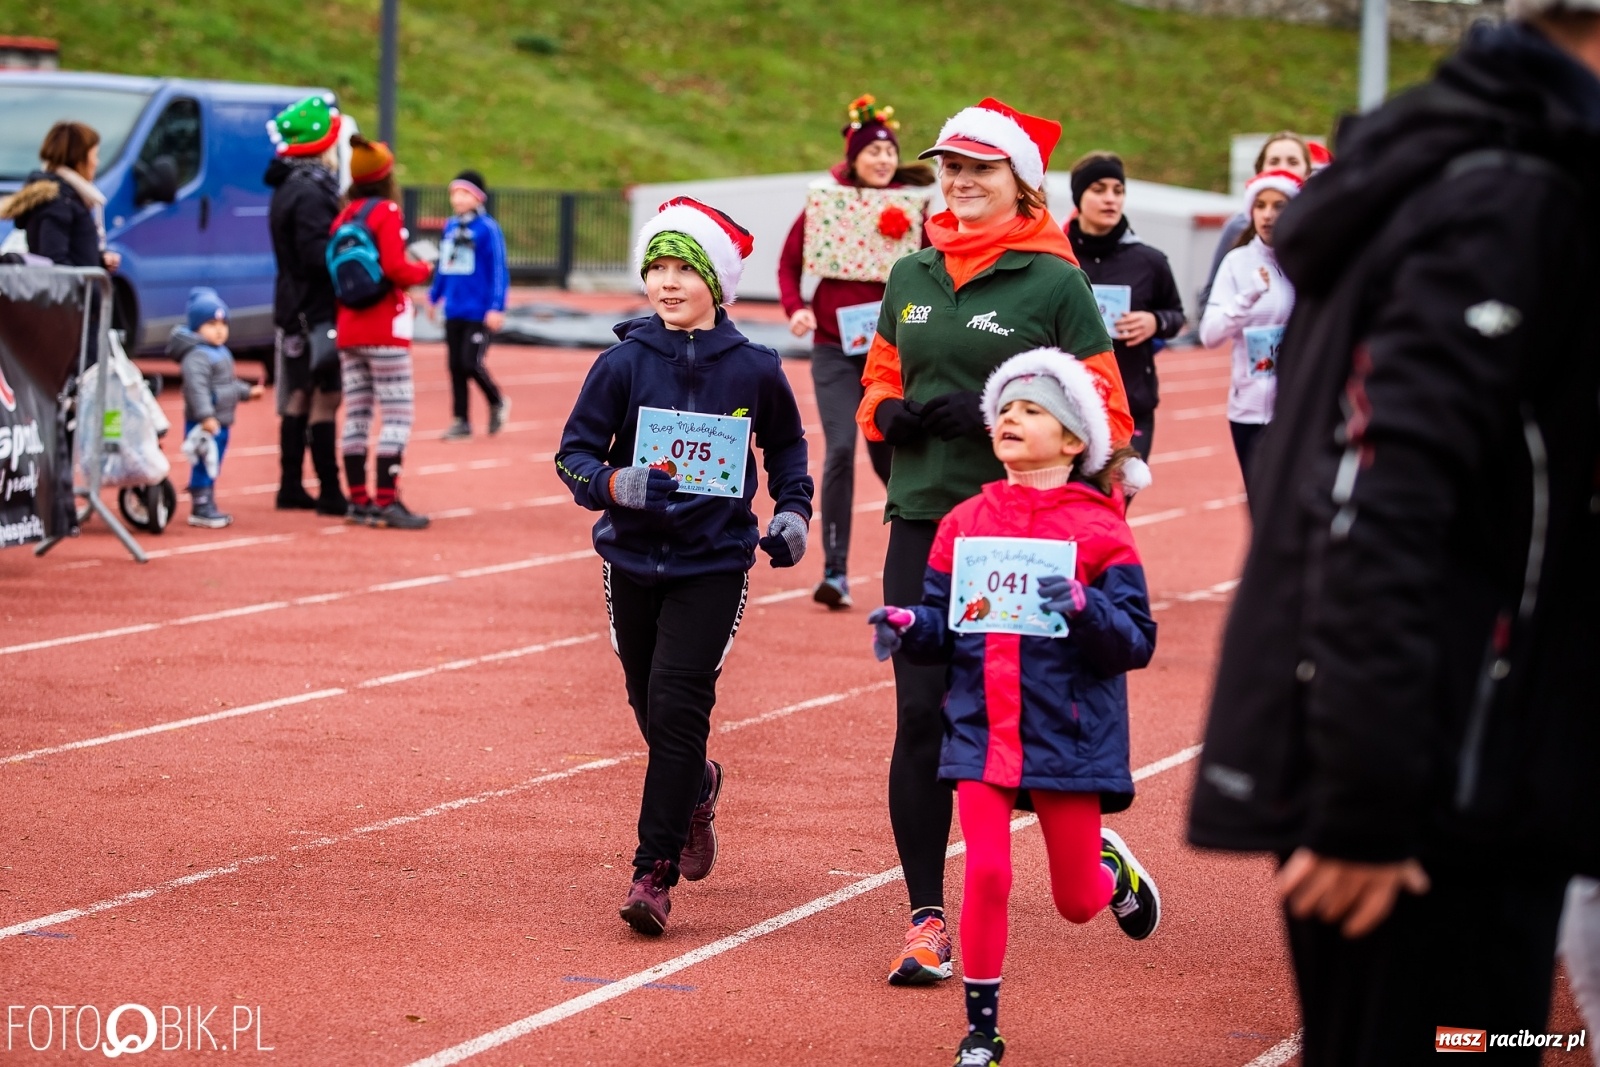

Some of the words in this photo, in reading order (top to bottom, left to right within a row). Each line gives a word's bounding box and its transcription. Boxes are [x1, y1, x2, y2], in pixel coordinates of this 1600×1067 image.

[910, 305, 932, 314] ZOO
[908, 312, 929, 321] MAR
[731, 408, 749, 418] 4F
[671, 438, 712, 462] 075
[988, 570, 1028, 595] 041
